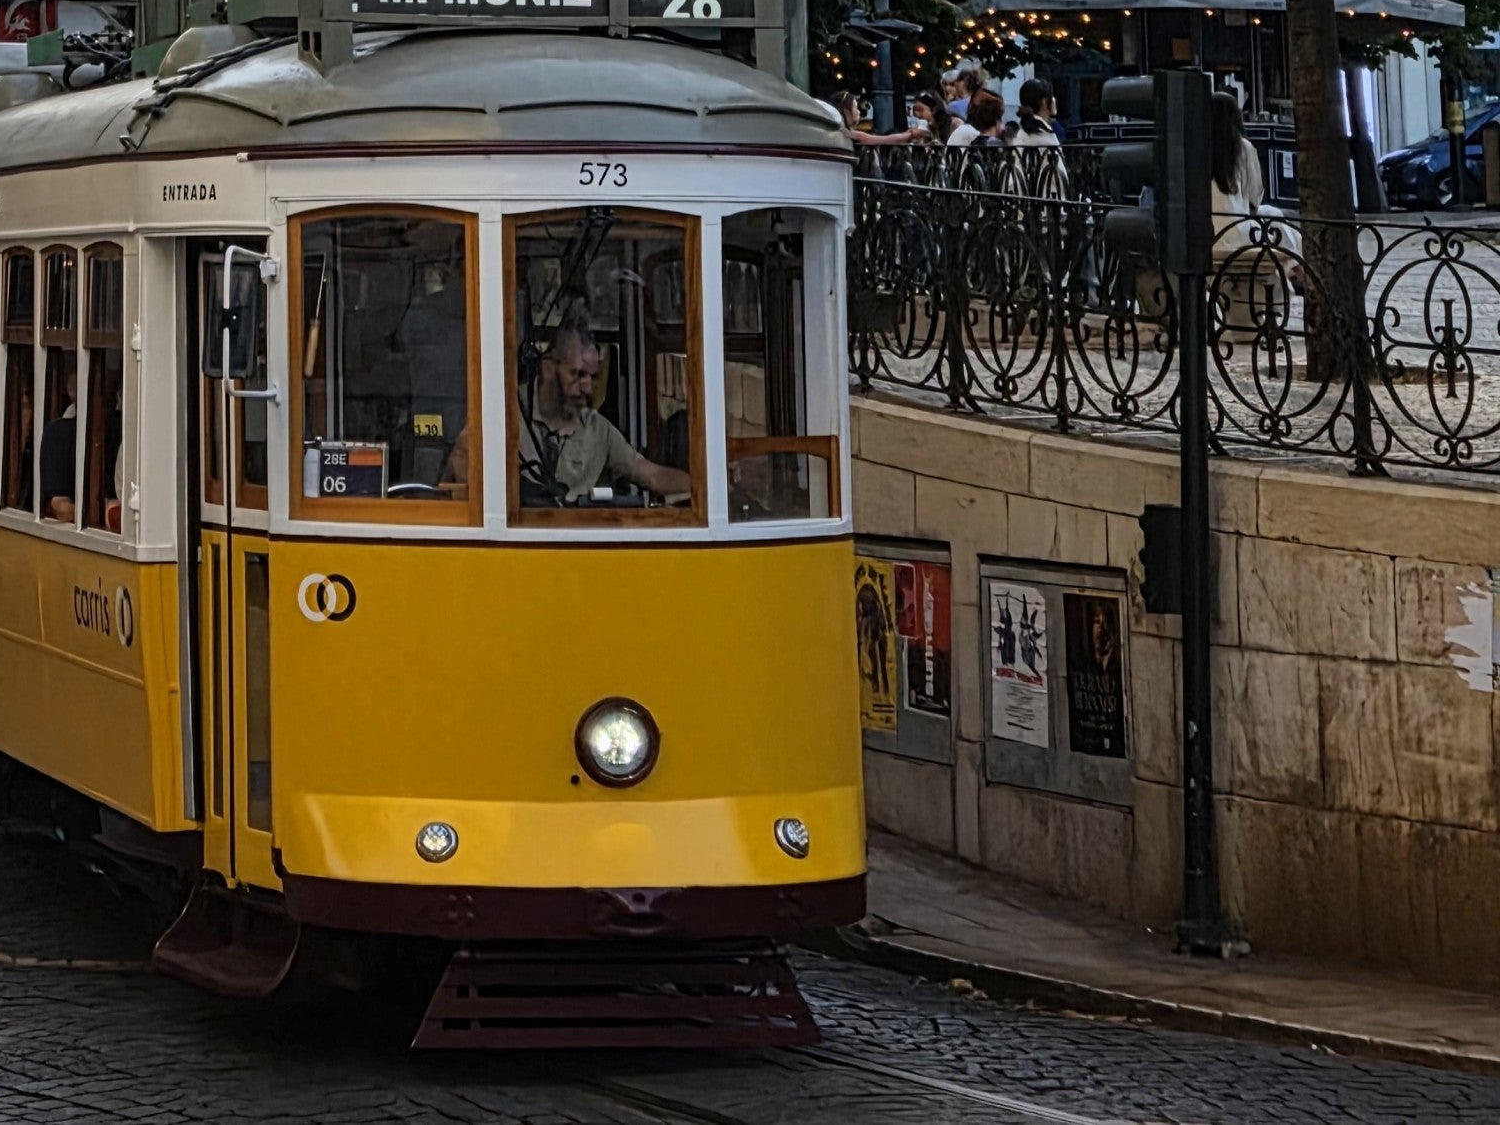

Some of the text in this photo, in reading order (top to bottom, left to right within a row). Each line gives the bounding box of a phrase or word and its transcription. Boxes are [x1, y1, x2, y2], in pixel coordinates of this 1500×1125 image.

[579, 161, 627, 187] 573
[163, 183, 217, 202] ENTRADA
[323, 453, 347, 466] 28E
[323, 476, 347, 493] 06
[74, 576, 110, 636] carris
